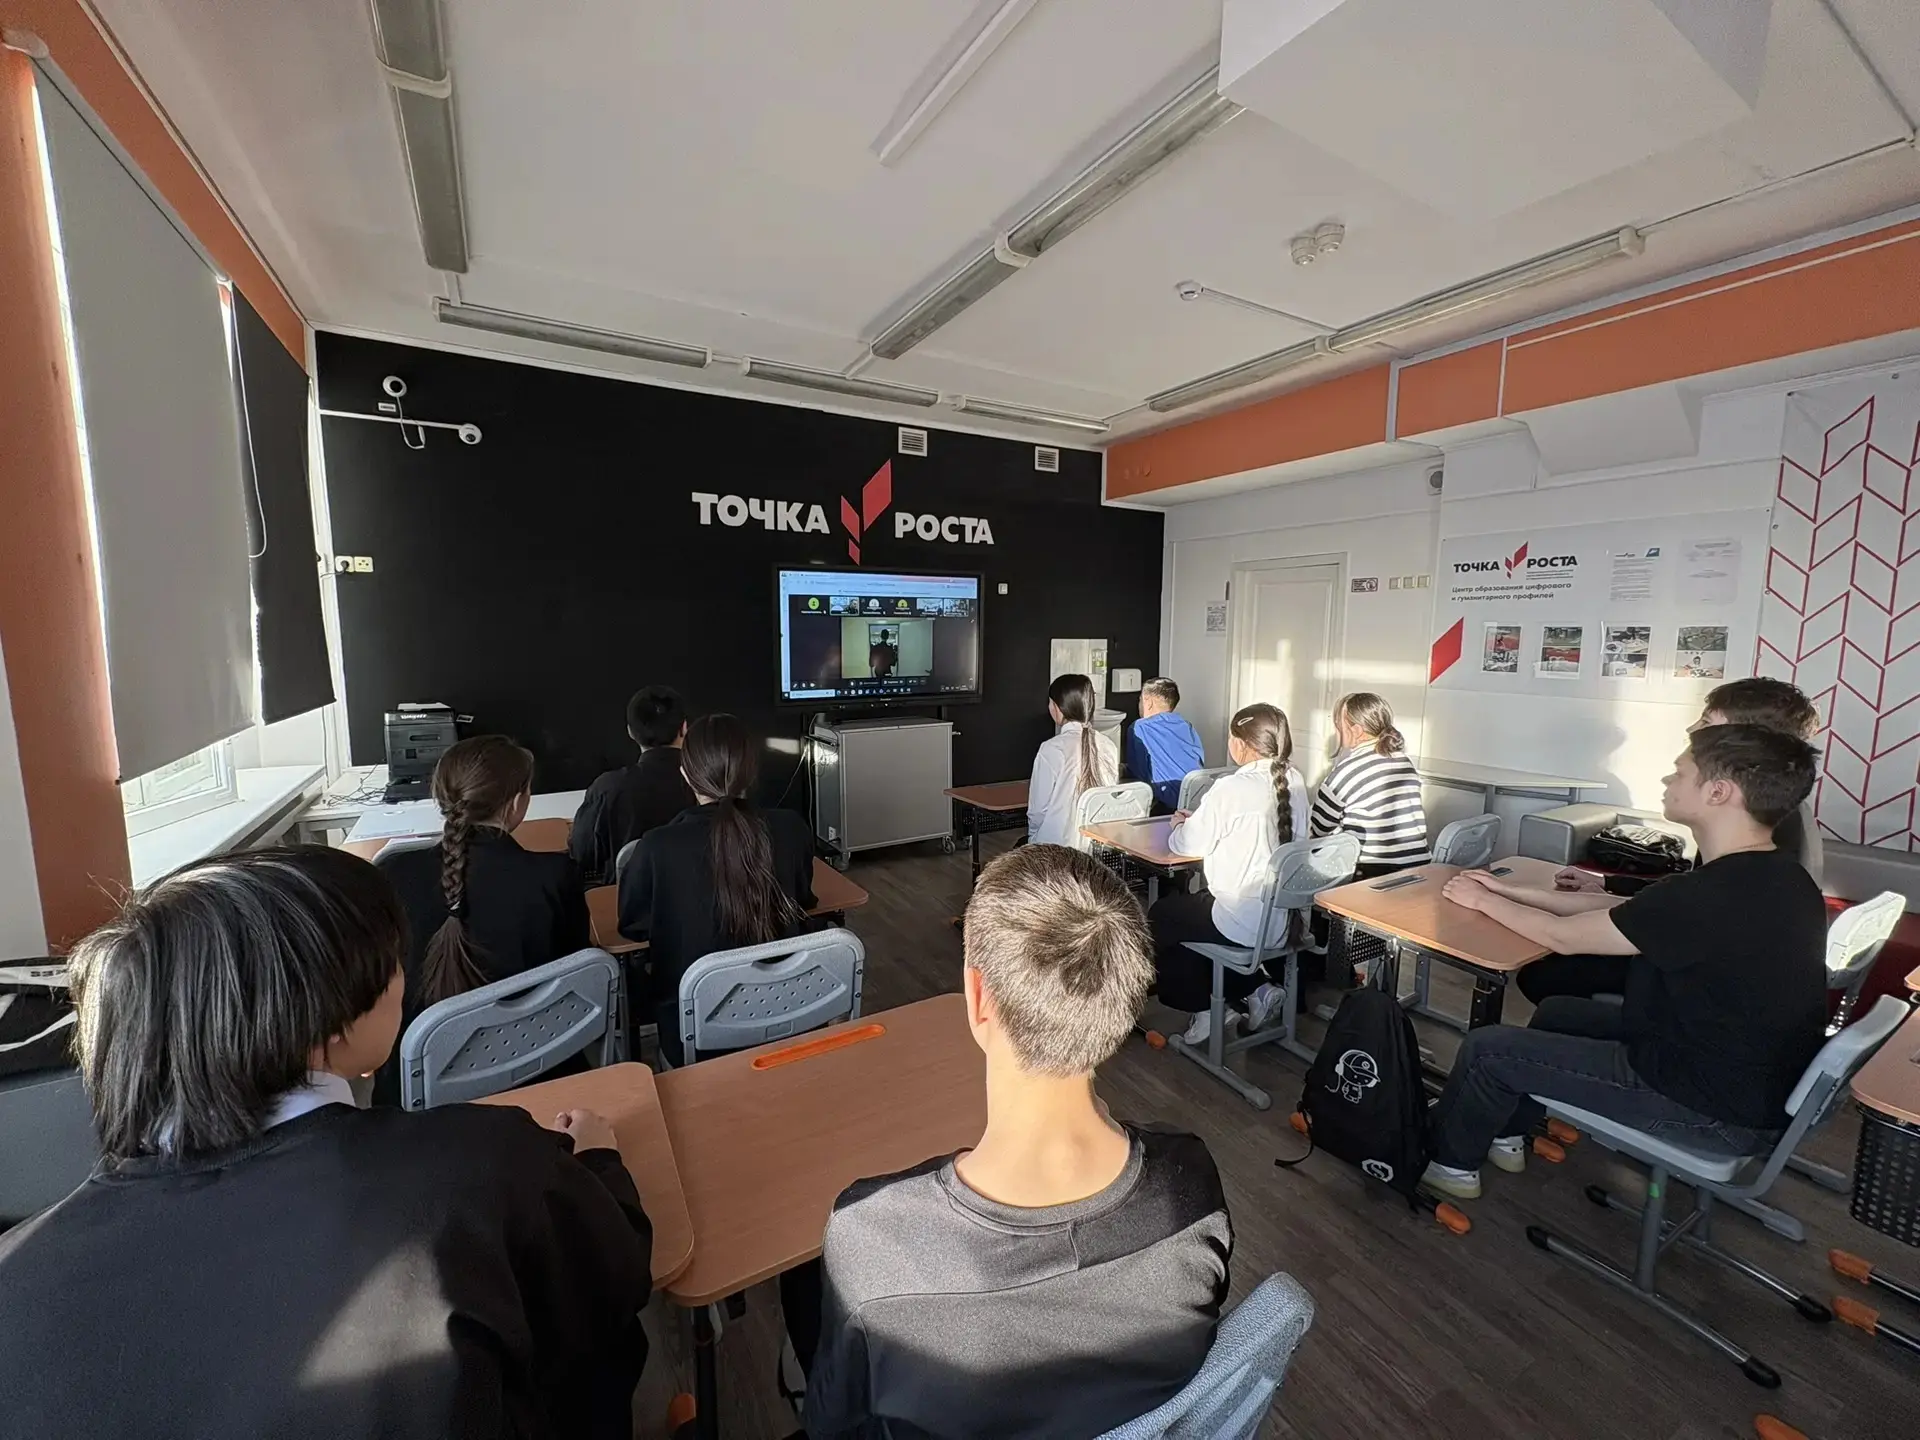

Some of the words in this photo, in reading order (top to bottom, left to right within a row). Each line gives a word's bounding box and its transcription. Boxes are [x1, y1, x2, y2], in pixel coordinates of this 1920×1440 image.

[692, 492, 830, 534] ТОЧКА
[894, 512, 994, 544] РОСТА
[1453, 561, 1500, 573] ТОЧКА
[1526, 555, 1578, 569] РОСТА
[1452, 586, 1473, 594] Центр
[1475, 584, 1523, 592] образования
[1525, 582, 1571, 591] цифрового
[1457, 594, 1511, 603] гуманитарного
[1512, 592, 1554, 600] профилей
